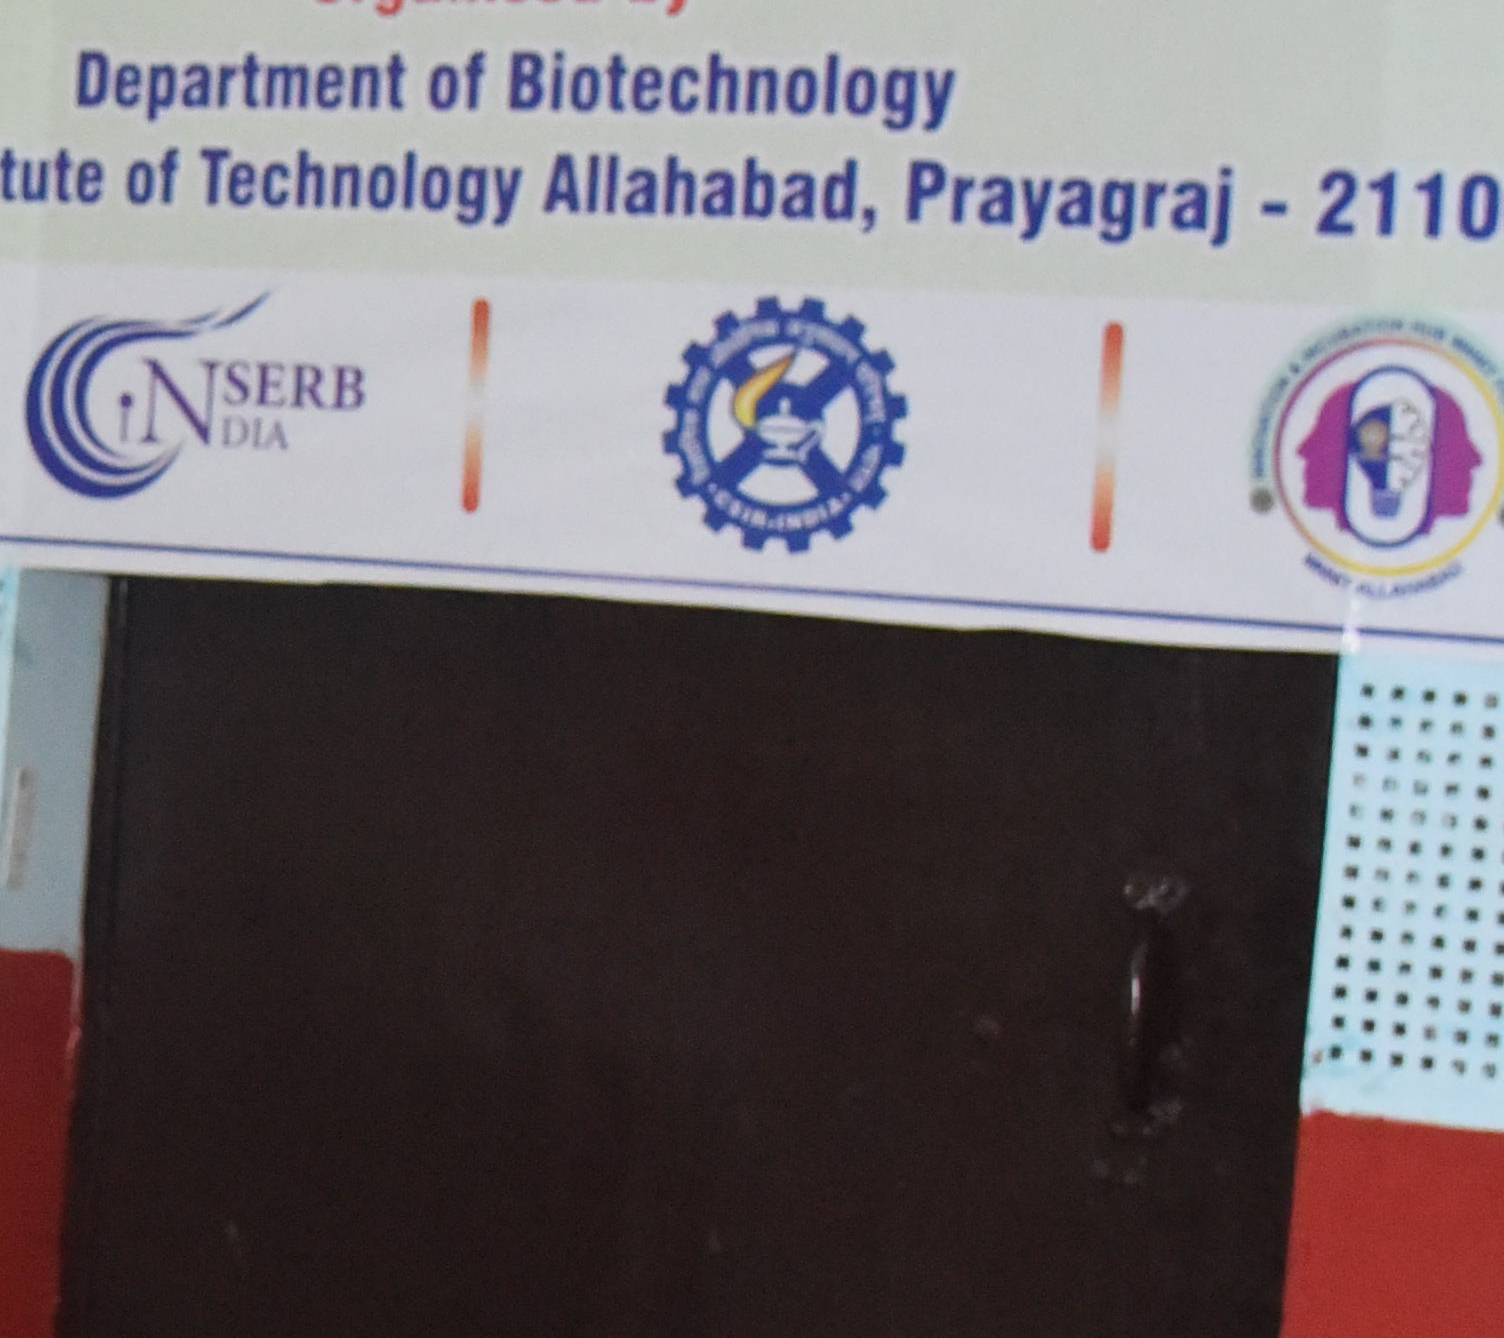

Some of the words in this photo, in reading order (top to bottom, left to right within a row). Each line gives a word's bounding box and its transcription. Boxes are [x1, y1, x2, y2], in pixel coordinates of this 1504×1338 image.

[76, 51, 408, 123] Department
[430, 51, 487, 114] of
[508, 51, 956, 135] Biotechnology
[126, 148, 181, 207] of
[200, 148, 524, 229] Technology
[543, 153, 878, 233] Allahabad,
[905, 159, 1234, 250] Prayagraj
[1261, 201, 1290, 219] -
